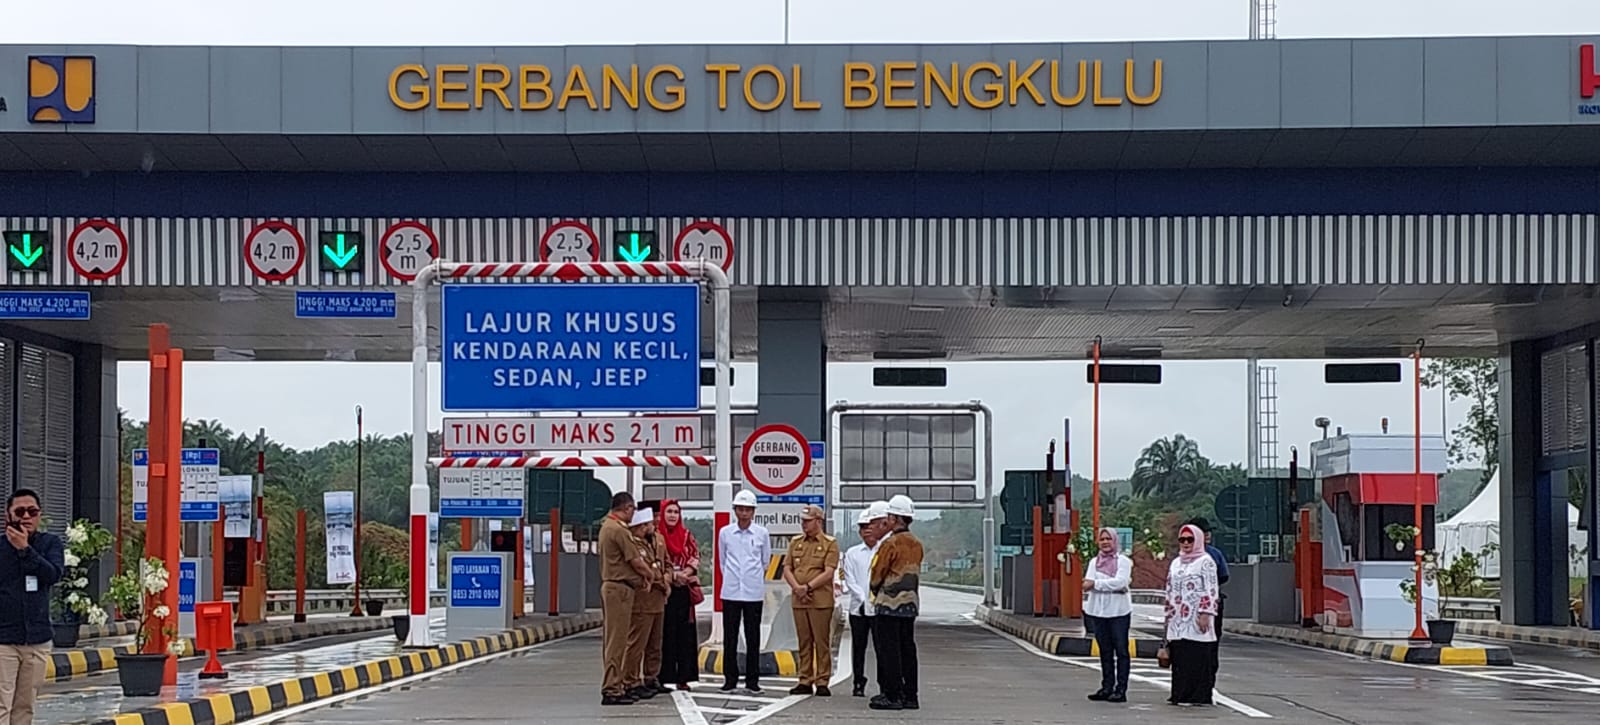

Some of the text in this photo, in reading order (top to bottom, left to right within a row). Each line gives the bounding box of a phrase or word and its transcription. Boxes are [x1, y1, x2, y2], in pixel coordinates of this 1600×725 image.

[388, 58, 1164, 111] GERBANG TOL BENGKULU
[395, 234, 422, 253] 2,5
[556, 233, 583, 252] 2,5
[76, 241, 118, 262] 4,2 m
[254, 242, 295, 262] 4,2 m
[709, 248, 723, 259] m
[401, 255, 416, 269] m
[20, 298, 43, 307] MAKS
[46, 298, 70, 308] 4.200
[298, 297, 395, 307] TINGGI MAKS 4.200 mm
[466, 312, 676, 333] LAJUR KHUSUS
[453, 342, 689, 361] KENDARAAN KECIL,
[493, 368, 647, 389] SEDAN, JEEP
[452, 423, 694, 446] TINGGI MAKS 2,1 m
[754, 441, 798, 453] GERBANG
[443, 476, 470, 484] TUJUAN
[767, 467, 784, 478] TOL
[754, 512, 779, 526] mpel
[452, 564, 500, 574] INFO LAYANAN TOL
